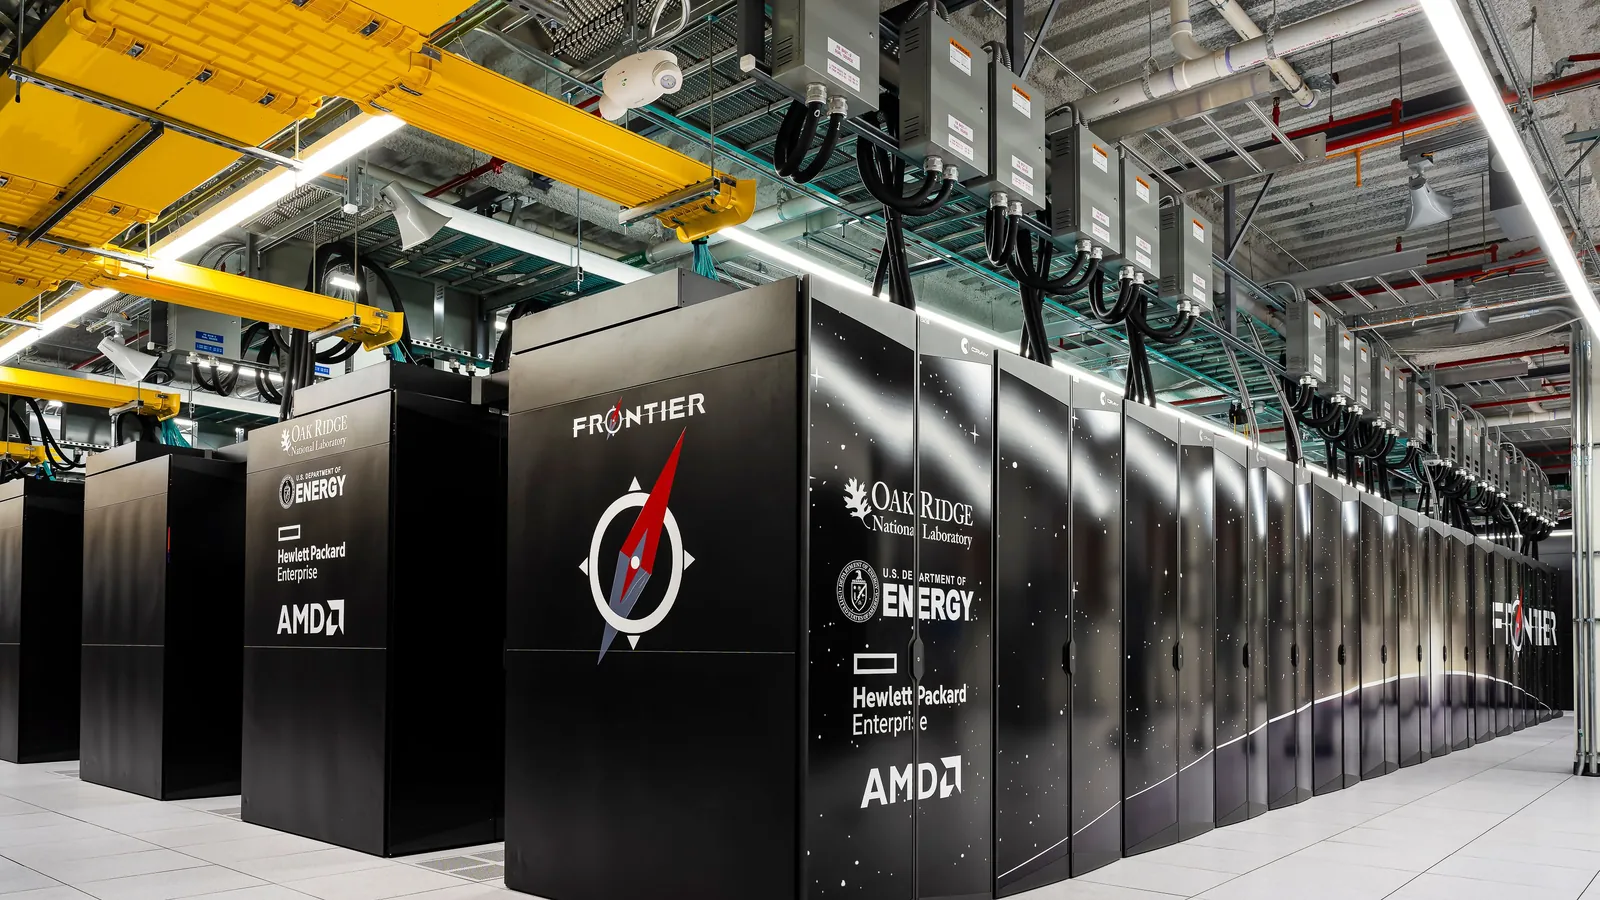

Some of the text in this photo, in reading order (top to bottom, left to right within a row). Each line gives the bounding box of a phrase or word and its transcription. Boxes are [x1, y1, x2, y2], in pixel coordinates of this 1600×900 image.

[291, 414, 348, 443] OAK RIDGE
[572, 392, 707, 440] FRONTIER
[291, 436, 348, 457] National Laboratory
[305, 467, 334, 480] DEPARTMENT
[334, 465, 342, 474] OF
[295, 474, 347, 504] ENERGY
[871, 480, 974, 527] OAK RIDGE
[872, 514, 973, 551] Nationa Laboratory
[277, 541, 346, 564] Hewlett Packard
[277, 564, 318, 584] Enterprise
[882, 567, 967, 586] U.S. DEARTMENT OF
[882, 582, 974, 621] ENERGY
[276, 602, 325, 634] AMD
[853, 683, 967, 709] Hewlett Packard
[860, 762, 938, 809] AMD
